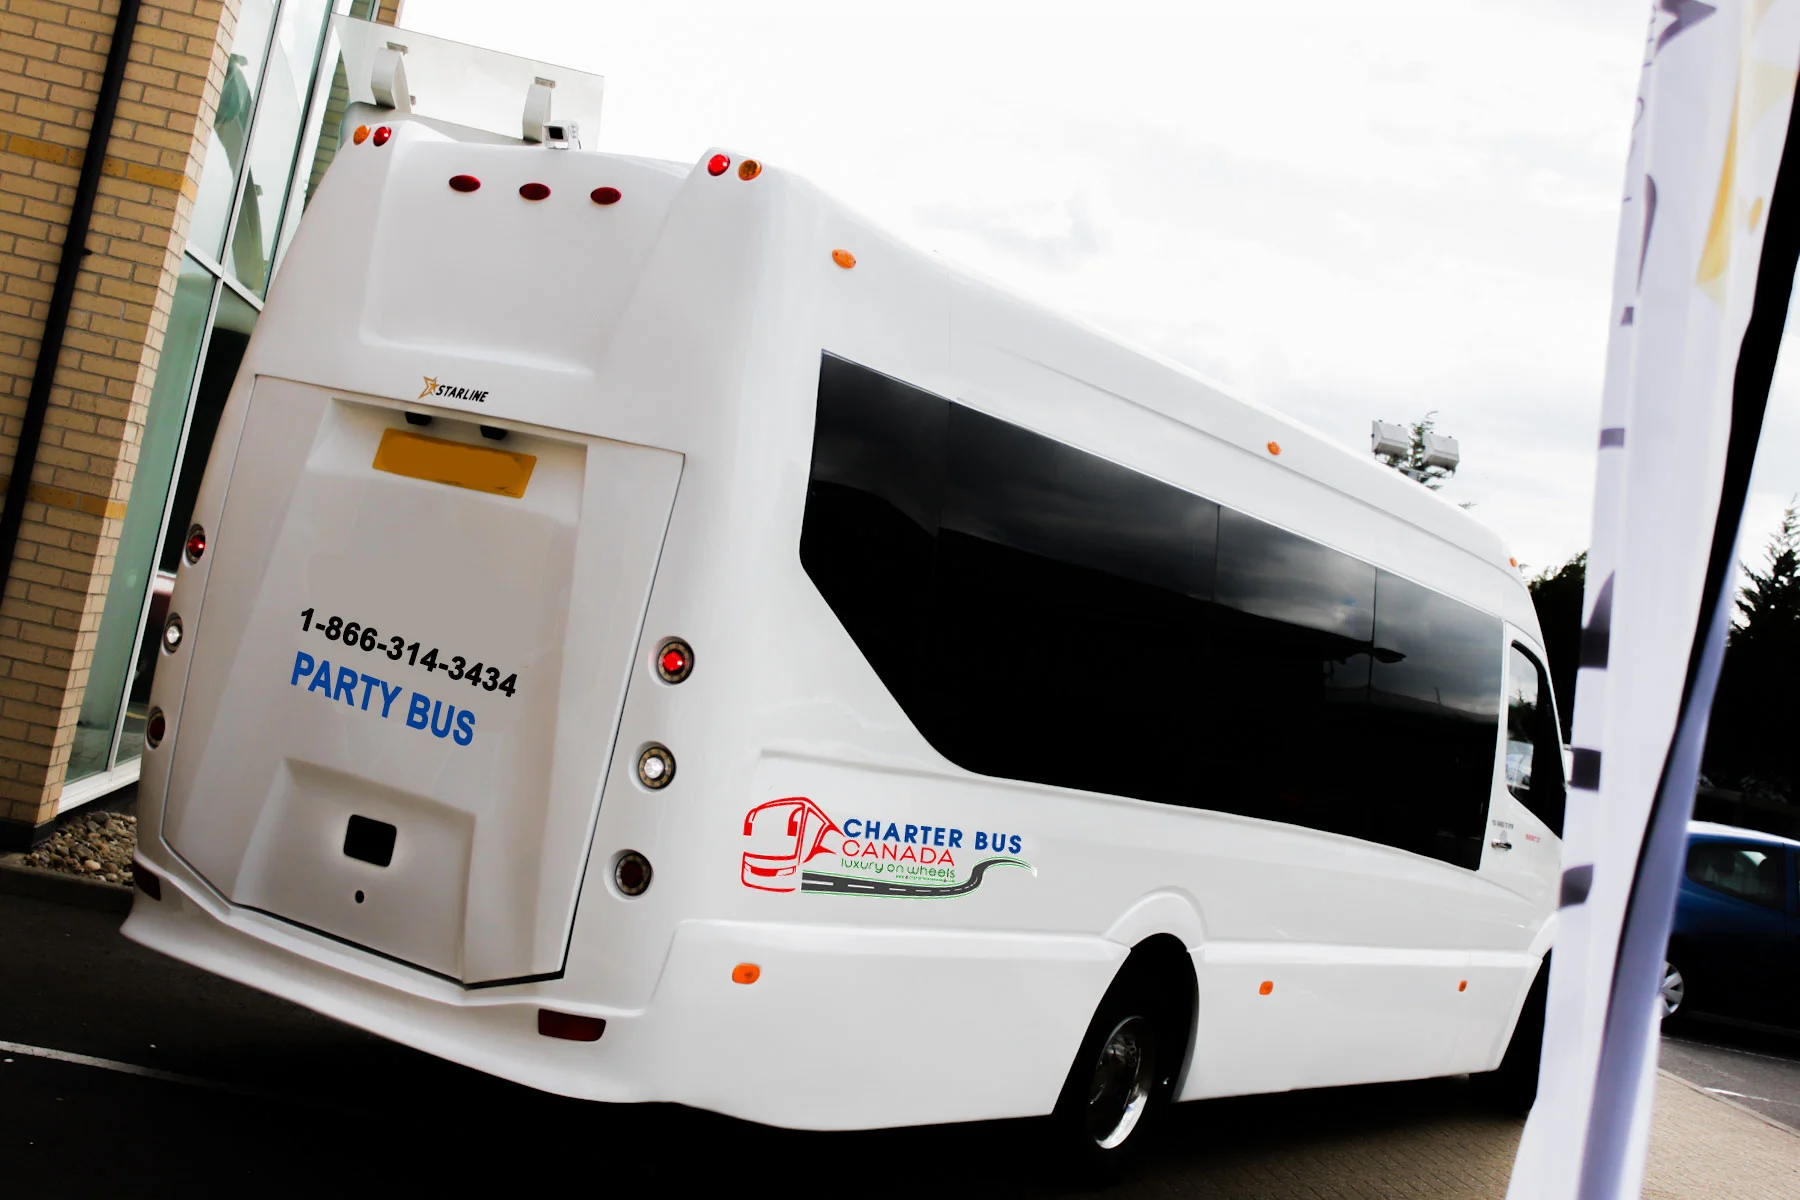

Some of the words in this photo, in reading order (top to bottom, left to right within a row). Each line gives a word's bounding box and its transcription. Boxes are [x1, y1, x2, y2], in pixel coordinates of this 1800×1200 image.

[435, 385, 489, 403] STARLINE
[300, 607, 518, 698] 1-866-314-3434
[290, 650, 403, 718] PARTY
[406, 692, 476, 747] BUS
[843, 818, 963, 849] CHARTER
[975, 831, 1022, 855] BUS
[840, 858, 885, 874] luxury
[887, 863, 904, 873] on
[907, 865, 956, 879] wheels
[842, 839, 955, 867] CANADA
